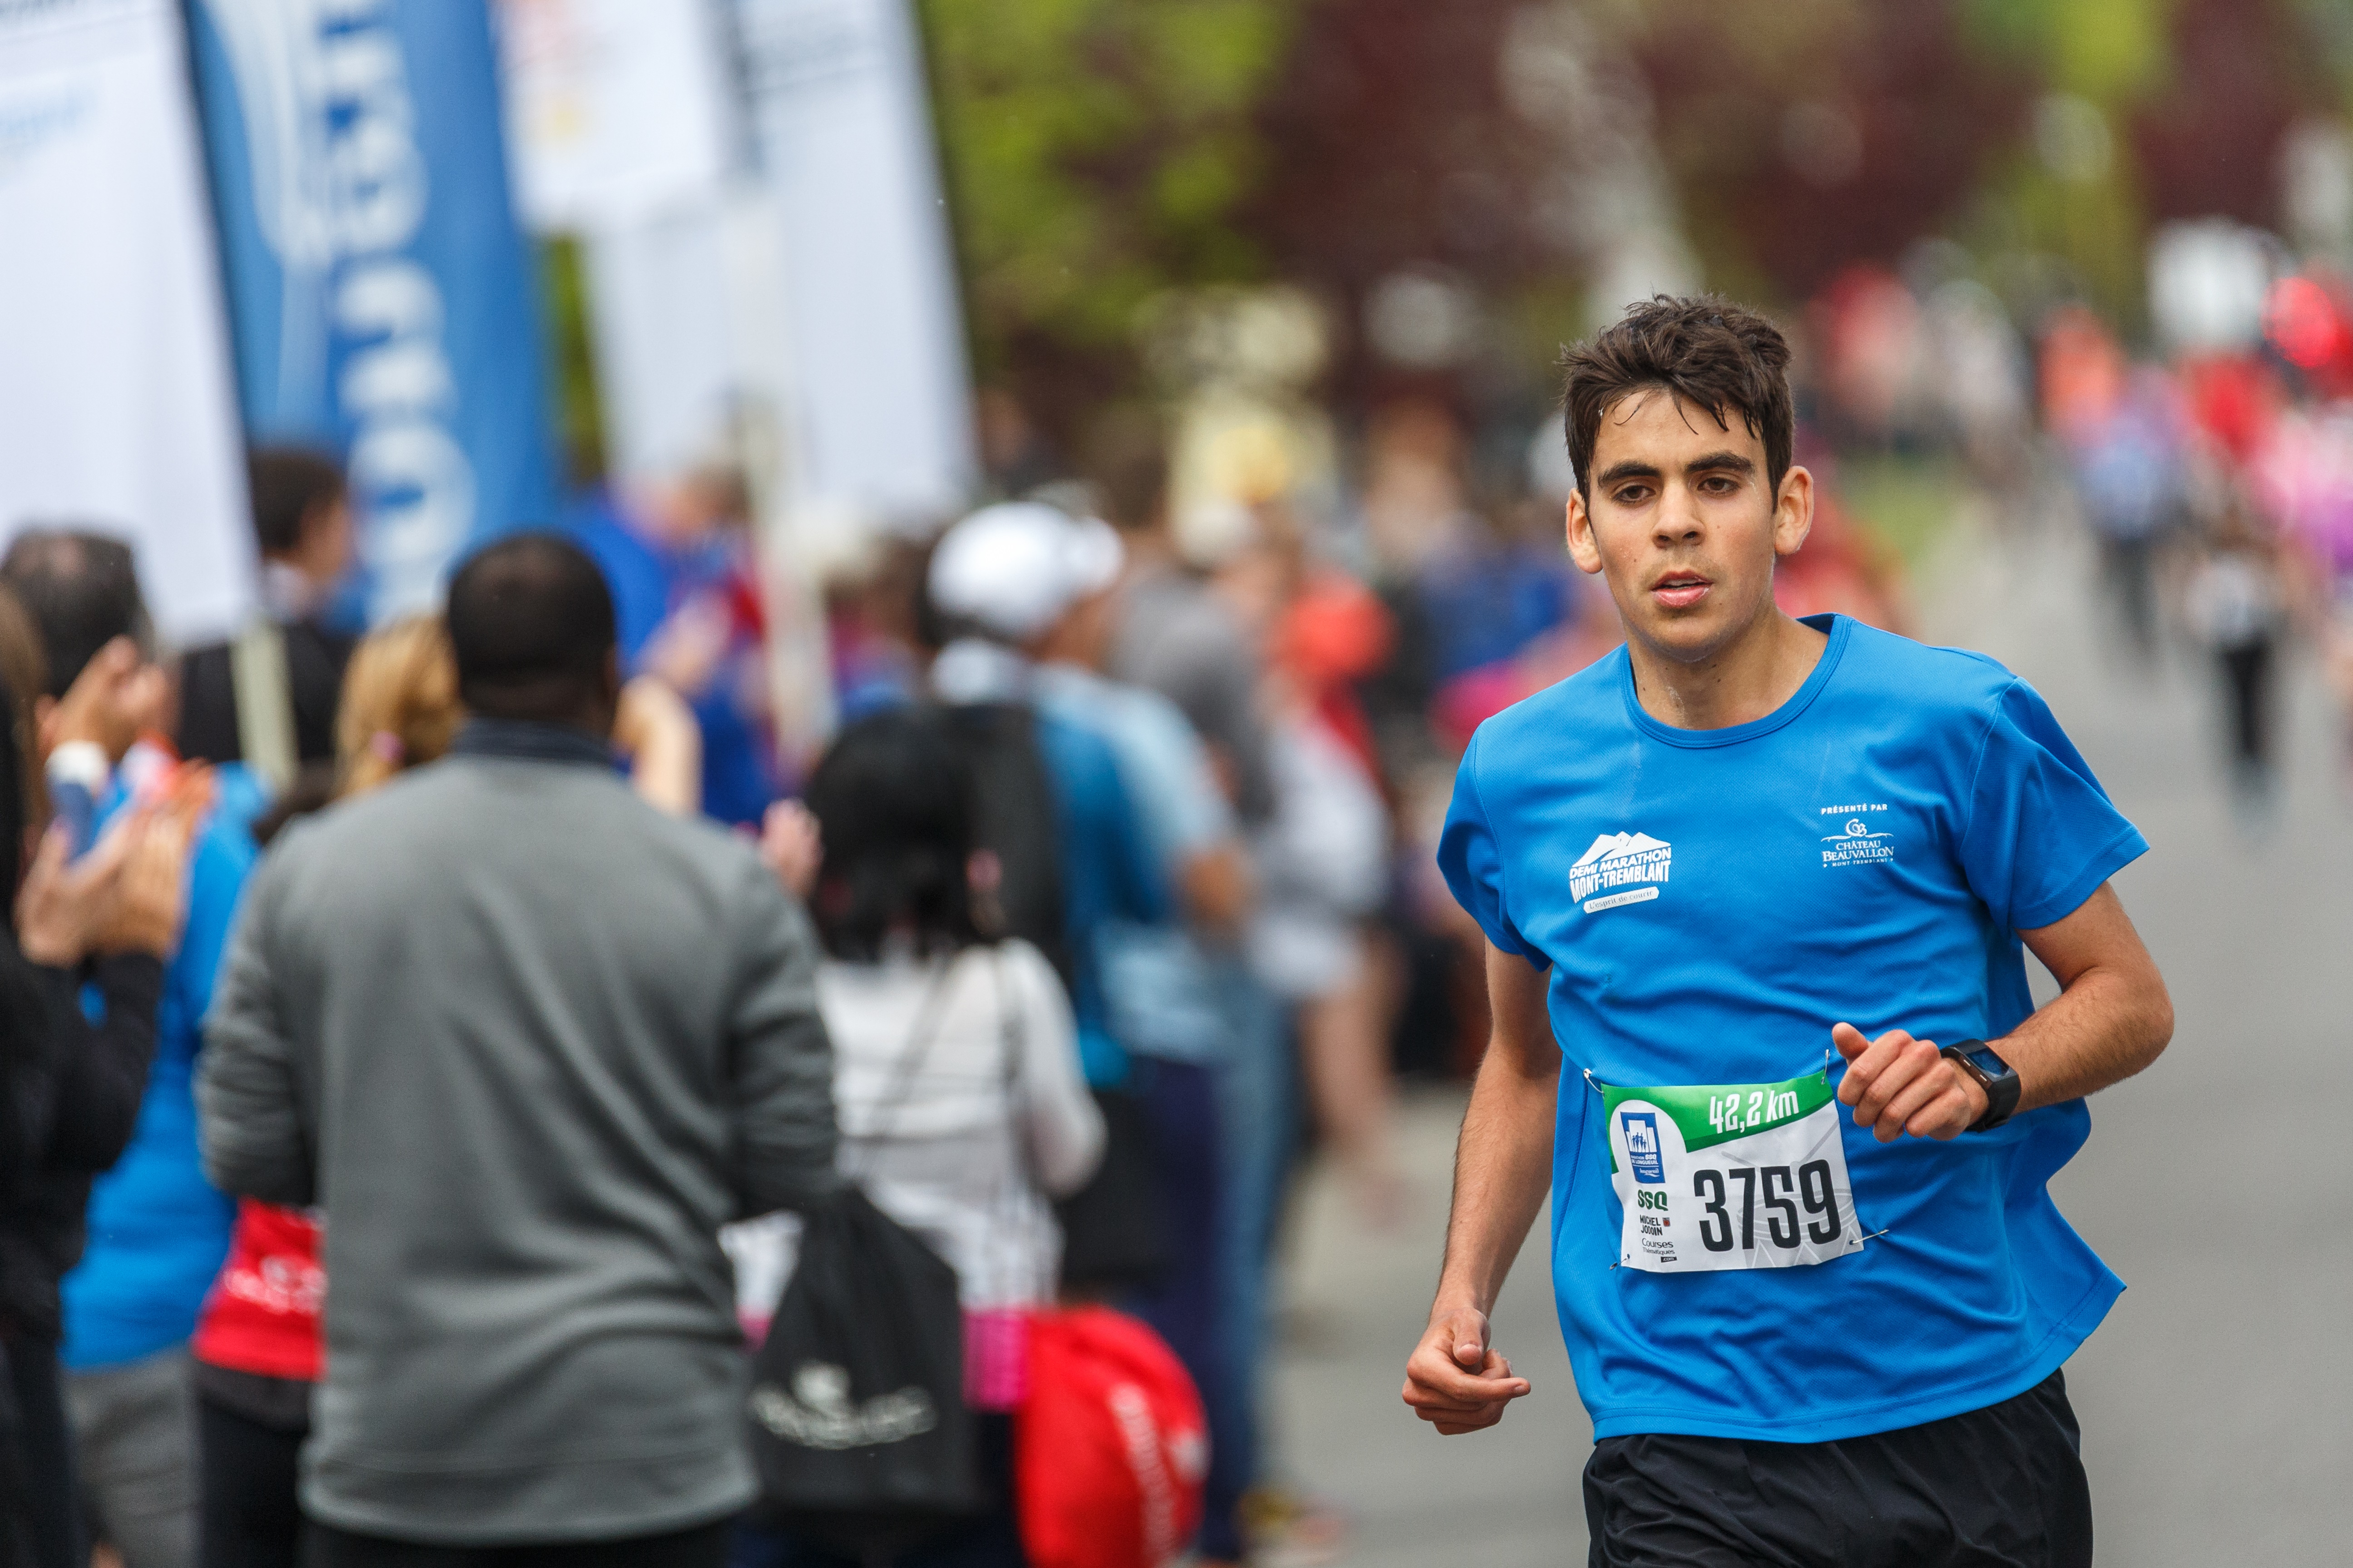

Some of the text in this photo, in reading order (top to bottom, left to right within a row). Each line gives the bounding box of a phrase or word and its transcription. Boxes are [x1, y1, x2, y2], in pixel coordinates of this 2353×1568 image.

[1821, 803, 1868, 815] PRÉSENTÉ
[1822, 846, 1894, 862] BEAUVALLON
[1836, 841, 1881, 851] CHÂTEAU
[1570, 847, 1672, 880] DEMI MARATHON
[1570, 860, 1671, 904] MONT-TREMBLANT
[1589, 898, 1616, 910] L'esprit
[1630, 890, 1653, 900] courir
[1709, 1090, 1799, 1134] 42,2 km
[1638, 1189, 1669, 1211] SSQ
[1694, 1159, 1842, 1252] 3759
[1640, 1214, 1661, 1226] MICHEL
[1640, 1224, 1663, 1236] JODOIN
[1642, 1237, 1674, 1248] Courses
[1642, 1246, 1675, 1256] Thématiques
